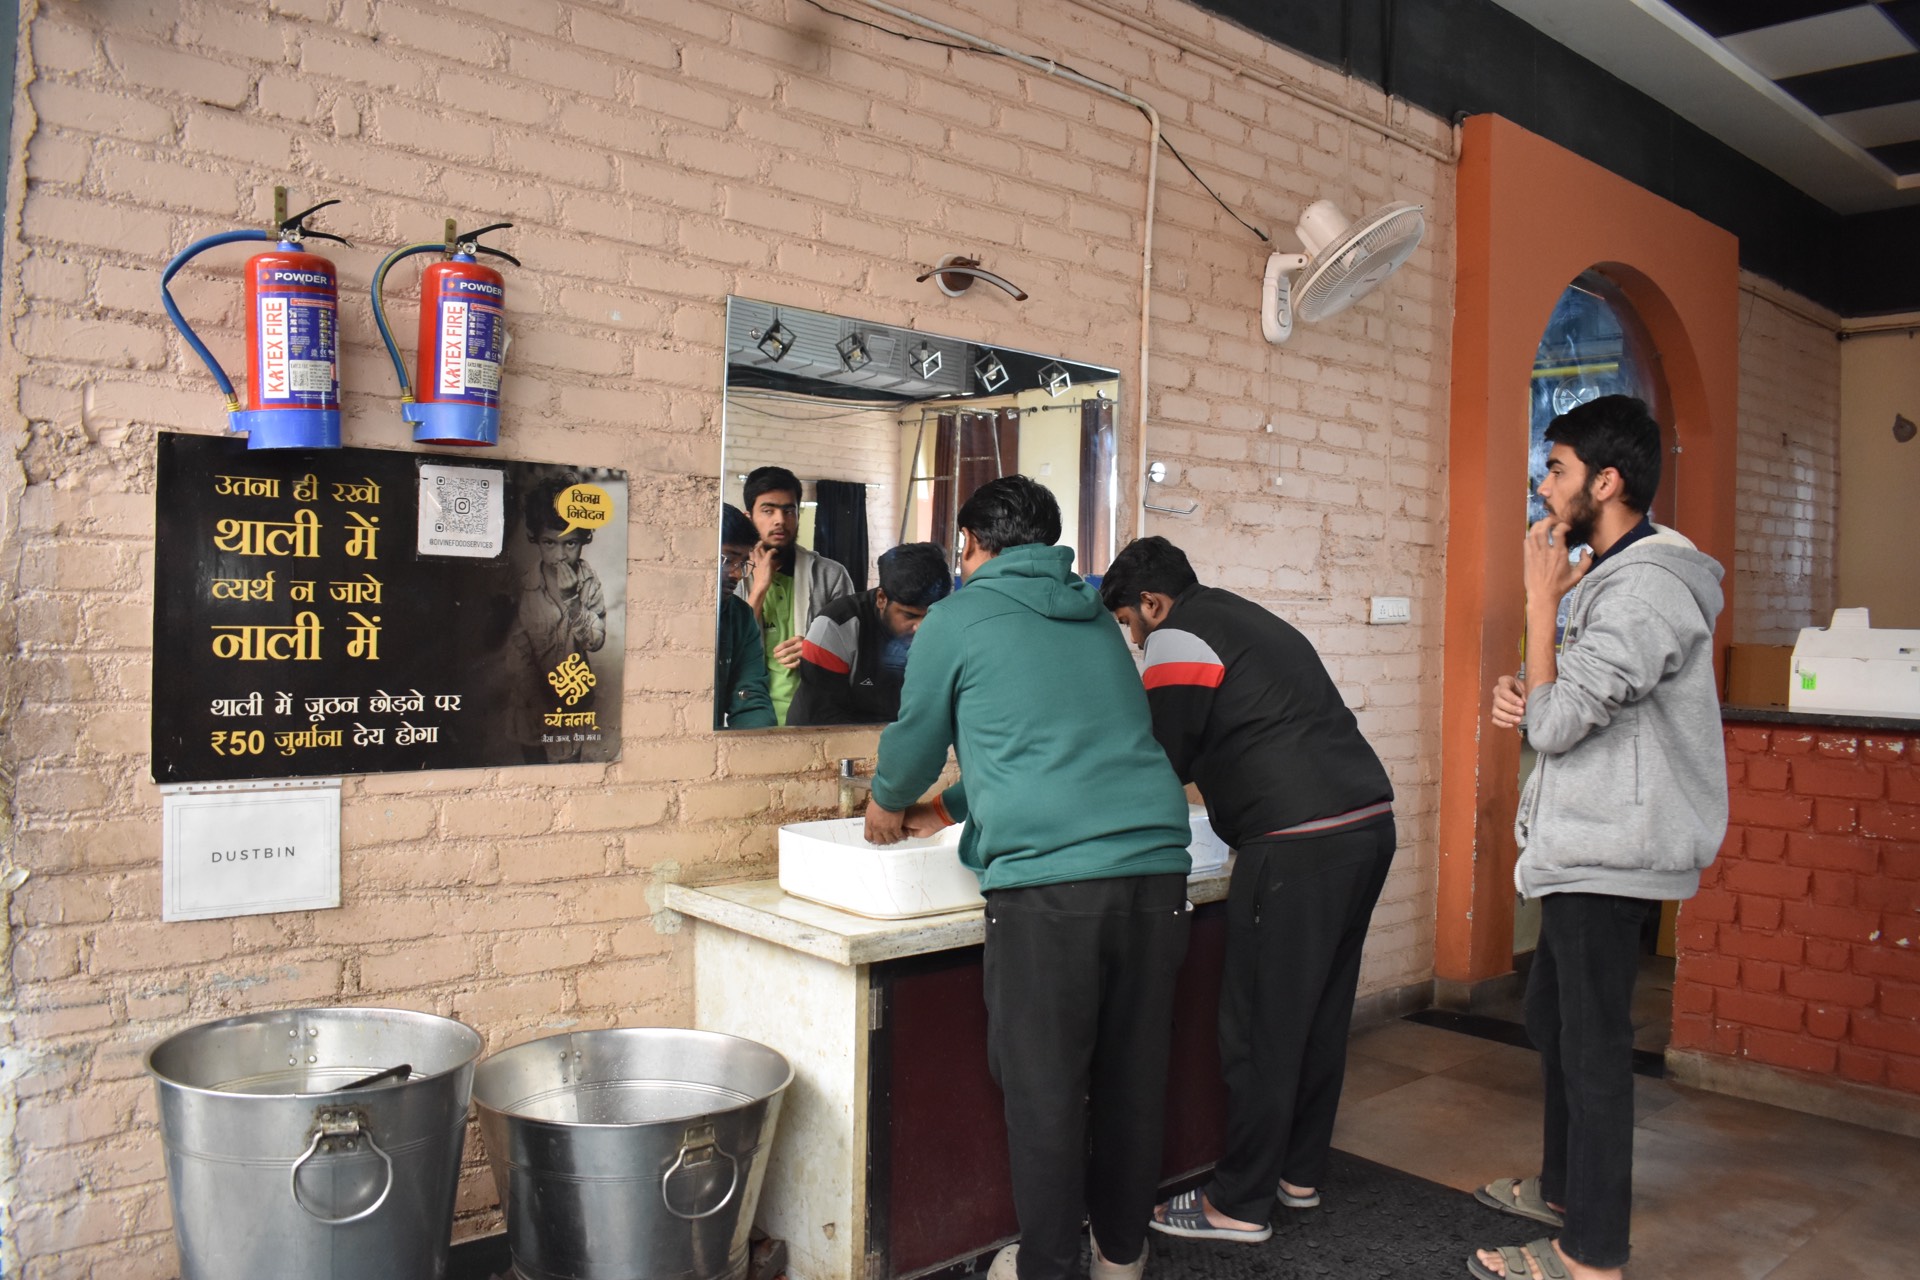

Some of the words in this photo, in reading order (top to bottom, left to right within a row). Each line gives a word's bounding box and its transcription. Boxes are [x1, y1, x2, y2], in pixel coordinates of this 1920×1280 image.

[274, 272, 328, 285] POWDER
[459, 282, 503, 296] POWDER
[266, 302, 283, 336] FIRE
[446, 306, 463, 337] FIRE
[267, 340, 284, 392] KATEX
[444, 341, 462, 389] KATEX
[214, 475, 281, 498] उतना
[292, 473, 320, 502] ही
[332, 477, 382, 504] रखो
[571, 488, 601, 505] विनम्र
[567, 504, 606, 521] निवेदन
[213, 508, 323, 558] थाली
[344, 511, 381, 560] में
[211, 570, 276, 602] व्यर्थ
[289, 580, 317, 603] न
[329, 573, 384, 604] जाये
[211, 611, 325, 661] नाली
[345, 611, 383, 660] में
[210, 691, 265, 717] थाली
[274, 691, 294, 715] में
[304, 697, 360, 722] जूठन
[369, 689, 426, 716] छोड़ने
[434, 694, 463, 712] पर
[543, 706, 601, 731] व्यंजनम्
[210, 729, 266, 756] ₹50
[274, 724, 344, 756] जुर्माना
[352, 722, 386, 747] देय
[394, 721, 440, 746] होगा
[211, 846, 296, 863] DUSTBIN
